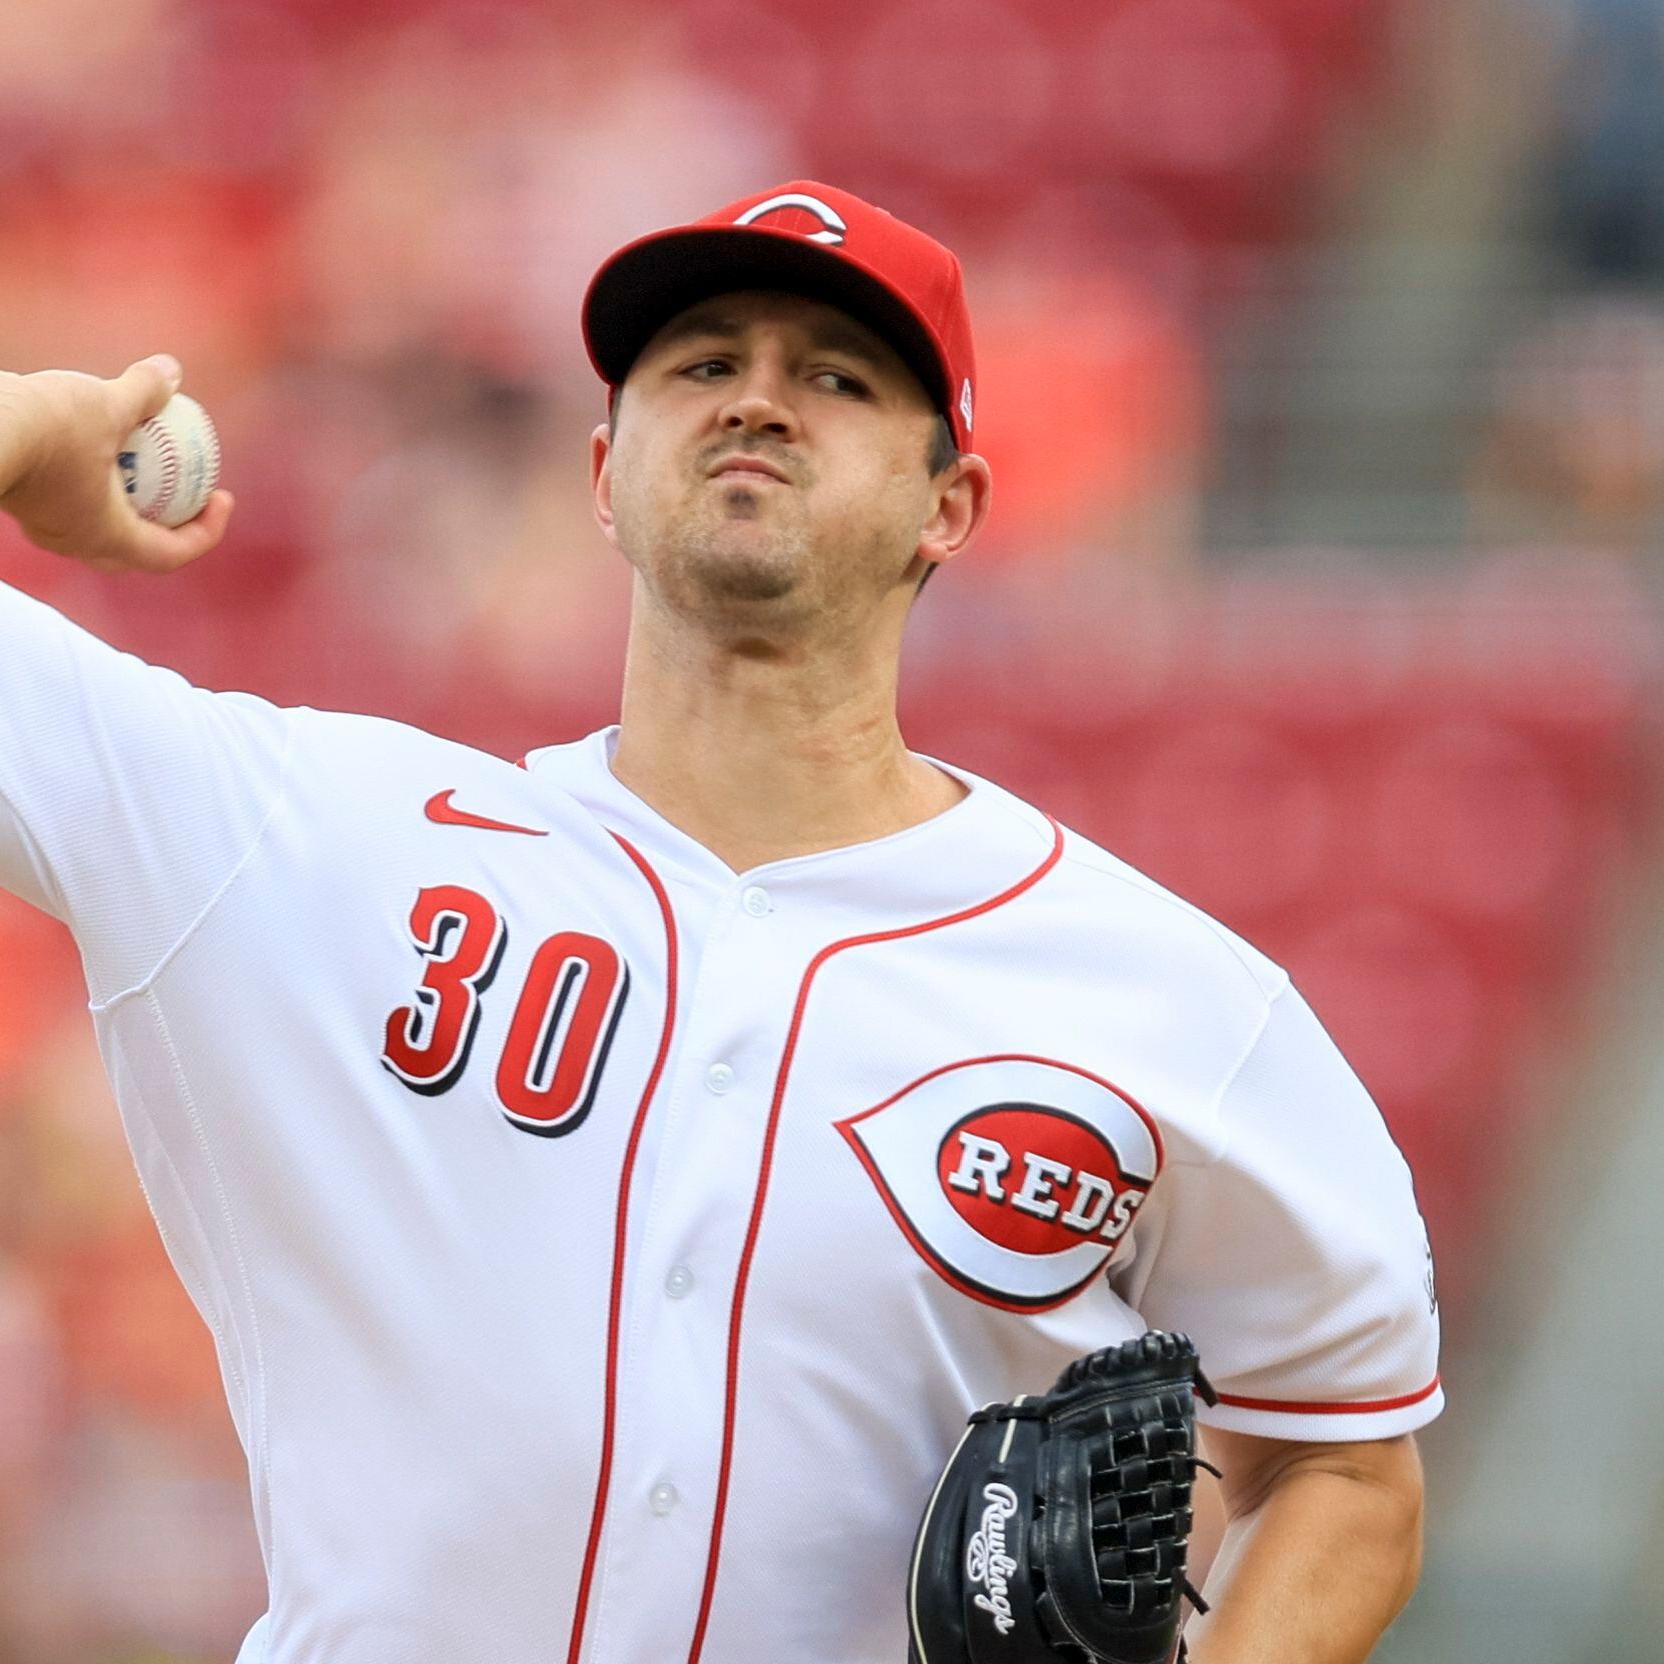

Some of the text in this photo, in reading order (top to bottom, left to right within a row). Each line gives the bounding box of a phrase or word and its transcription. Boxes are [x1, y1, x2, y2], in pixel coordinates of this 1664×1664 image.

[380, 884, 632, 1139] 30
[948, 1130, 1146, 1241] REDS
[973, 1482, 1019, 1635] Rawlings
